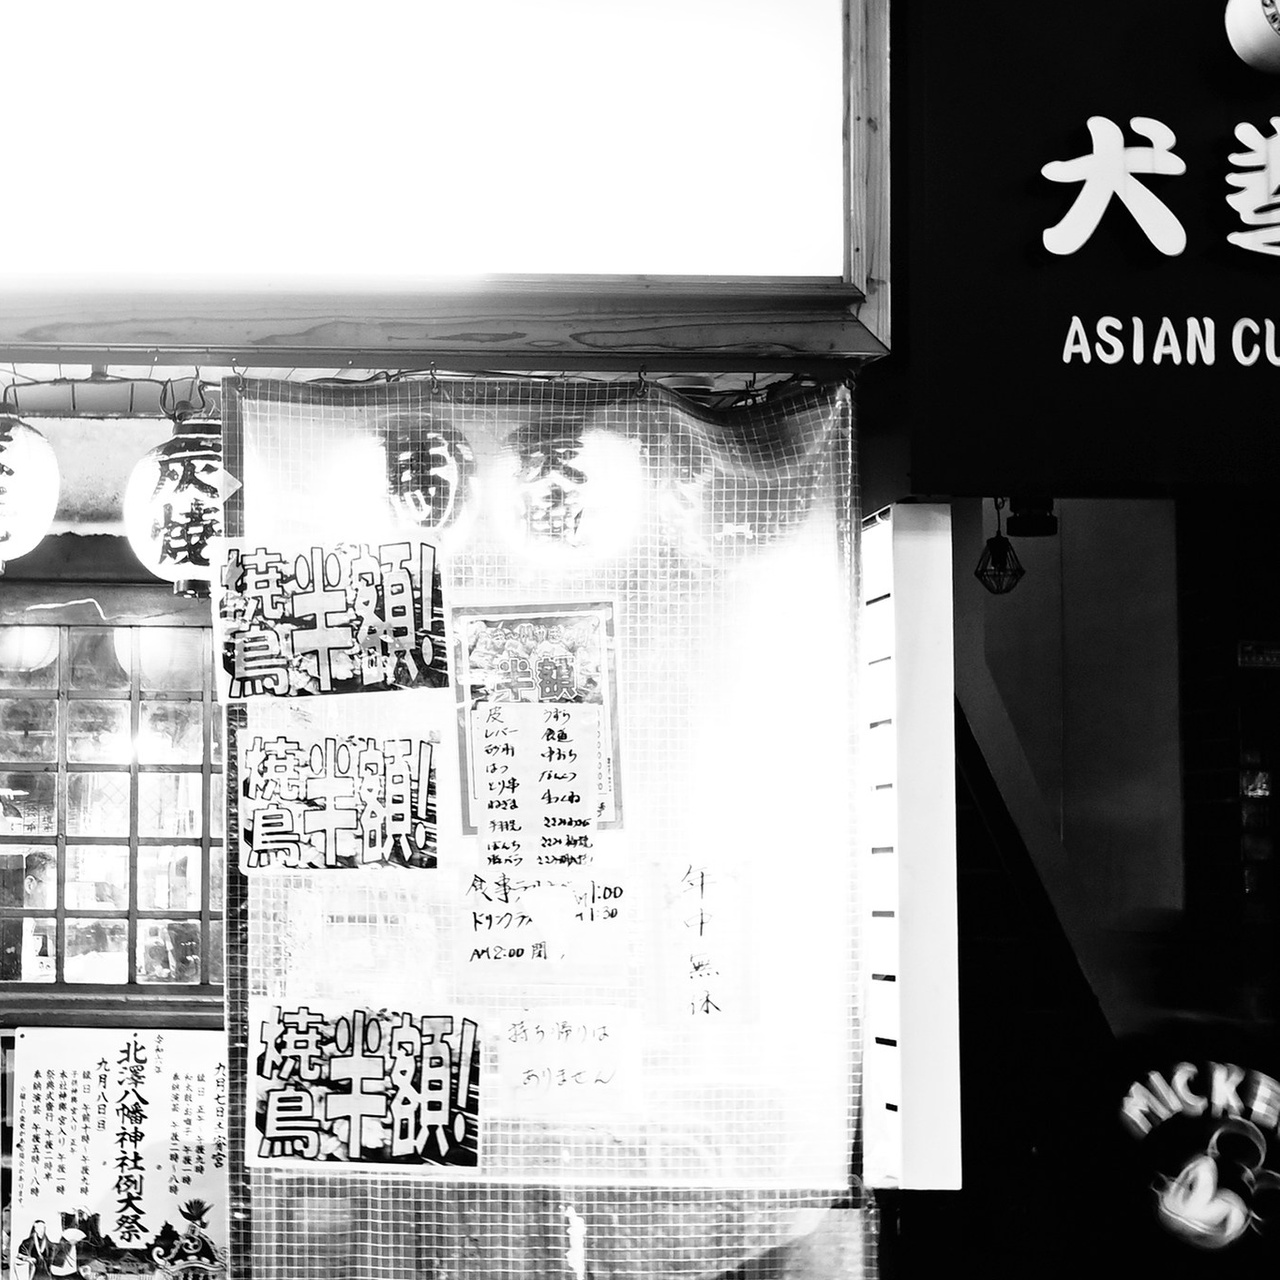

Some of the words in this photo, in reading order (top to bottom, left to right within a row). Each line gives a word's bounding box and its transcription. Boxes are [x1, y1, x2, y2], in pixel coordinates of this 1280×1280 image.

[1062, 315, 1216, 366] ASIAN
[495, 655, 578, 702] 半額
[484, 726, 519, 739] レバー
[681, 863, 723, 1016] 年中無休
[507, 1019, 610, 1044] 持ち帰りは
[521, 1067, 617, 1089] ありません
[1122, 1061, 1280, 1140] MICKE
[112, 1039, 149, 1242] 北澤八幡神社例大祭
